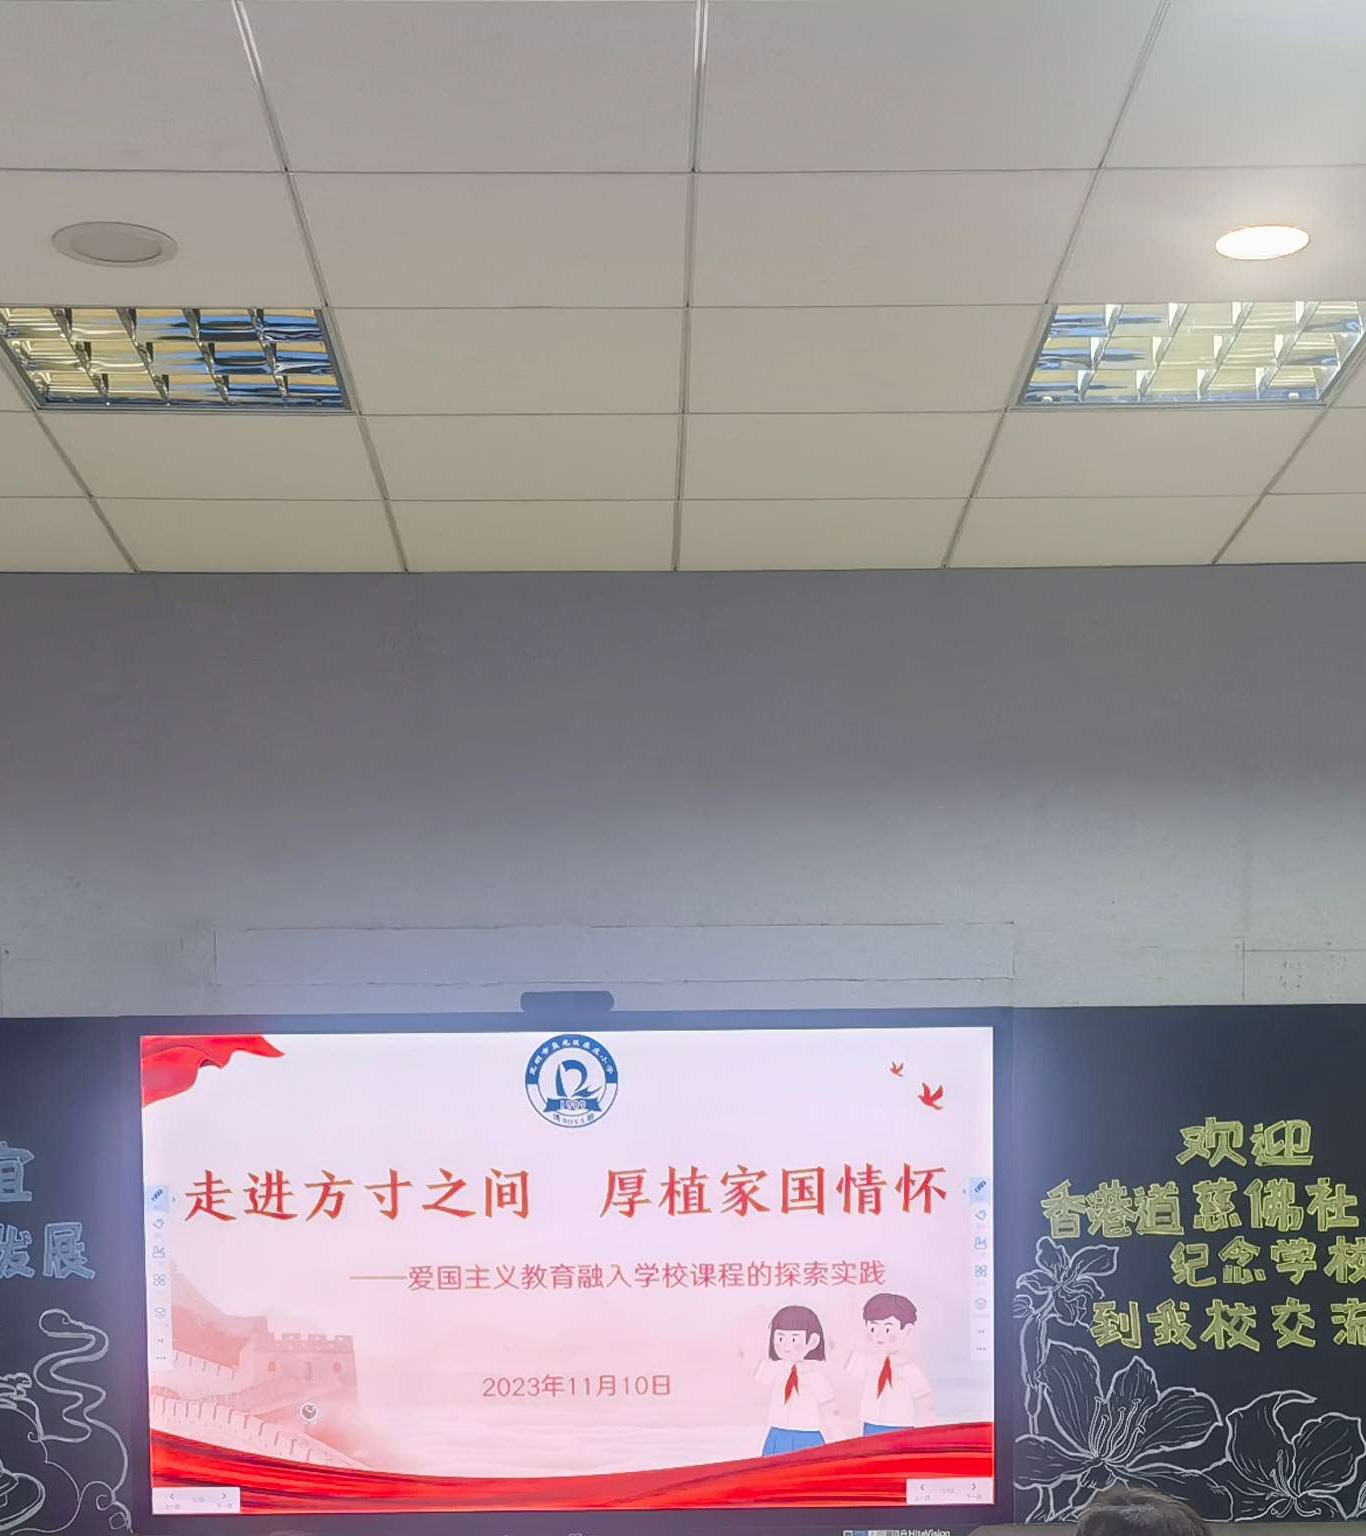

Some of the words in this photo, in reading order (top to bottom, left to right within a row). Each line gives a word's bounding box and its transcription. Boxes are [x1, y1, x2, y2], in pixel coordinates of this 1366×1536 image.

[1176, 1117, 1314, 1167] 欢迎
[184, 1168, 530, 1222] 走进方寸之间
[599, 1162, 948, 1218] 厚植家国情怀
[482, 1373, 672, 1398] 2023年11月10日
